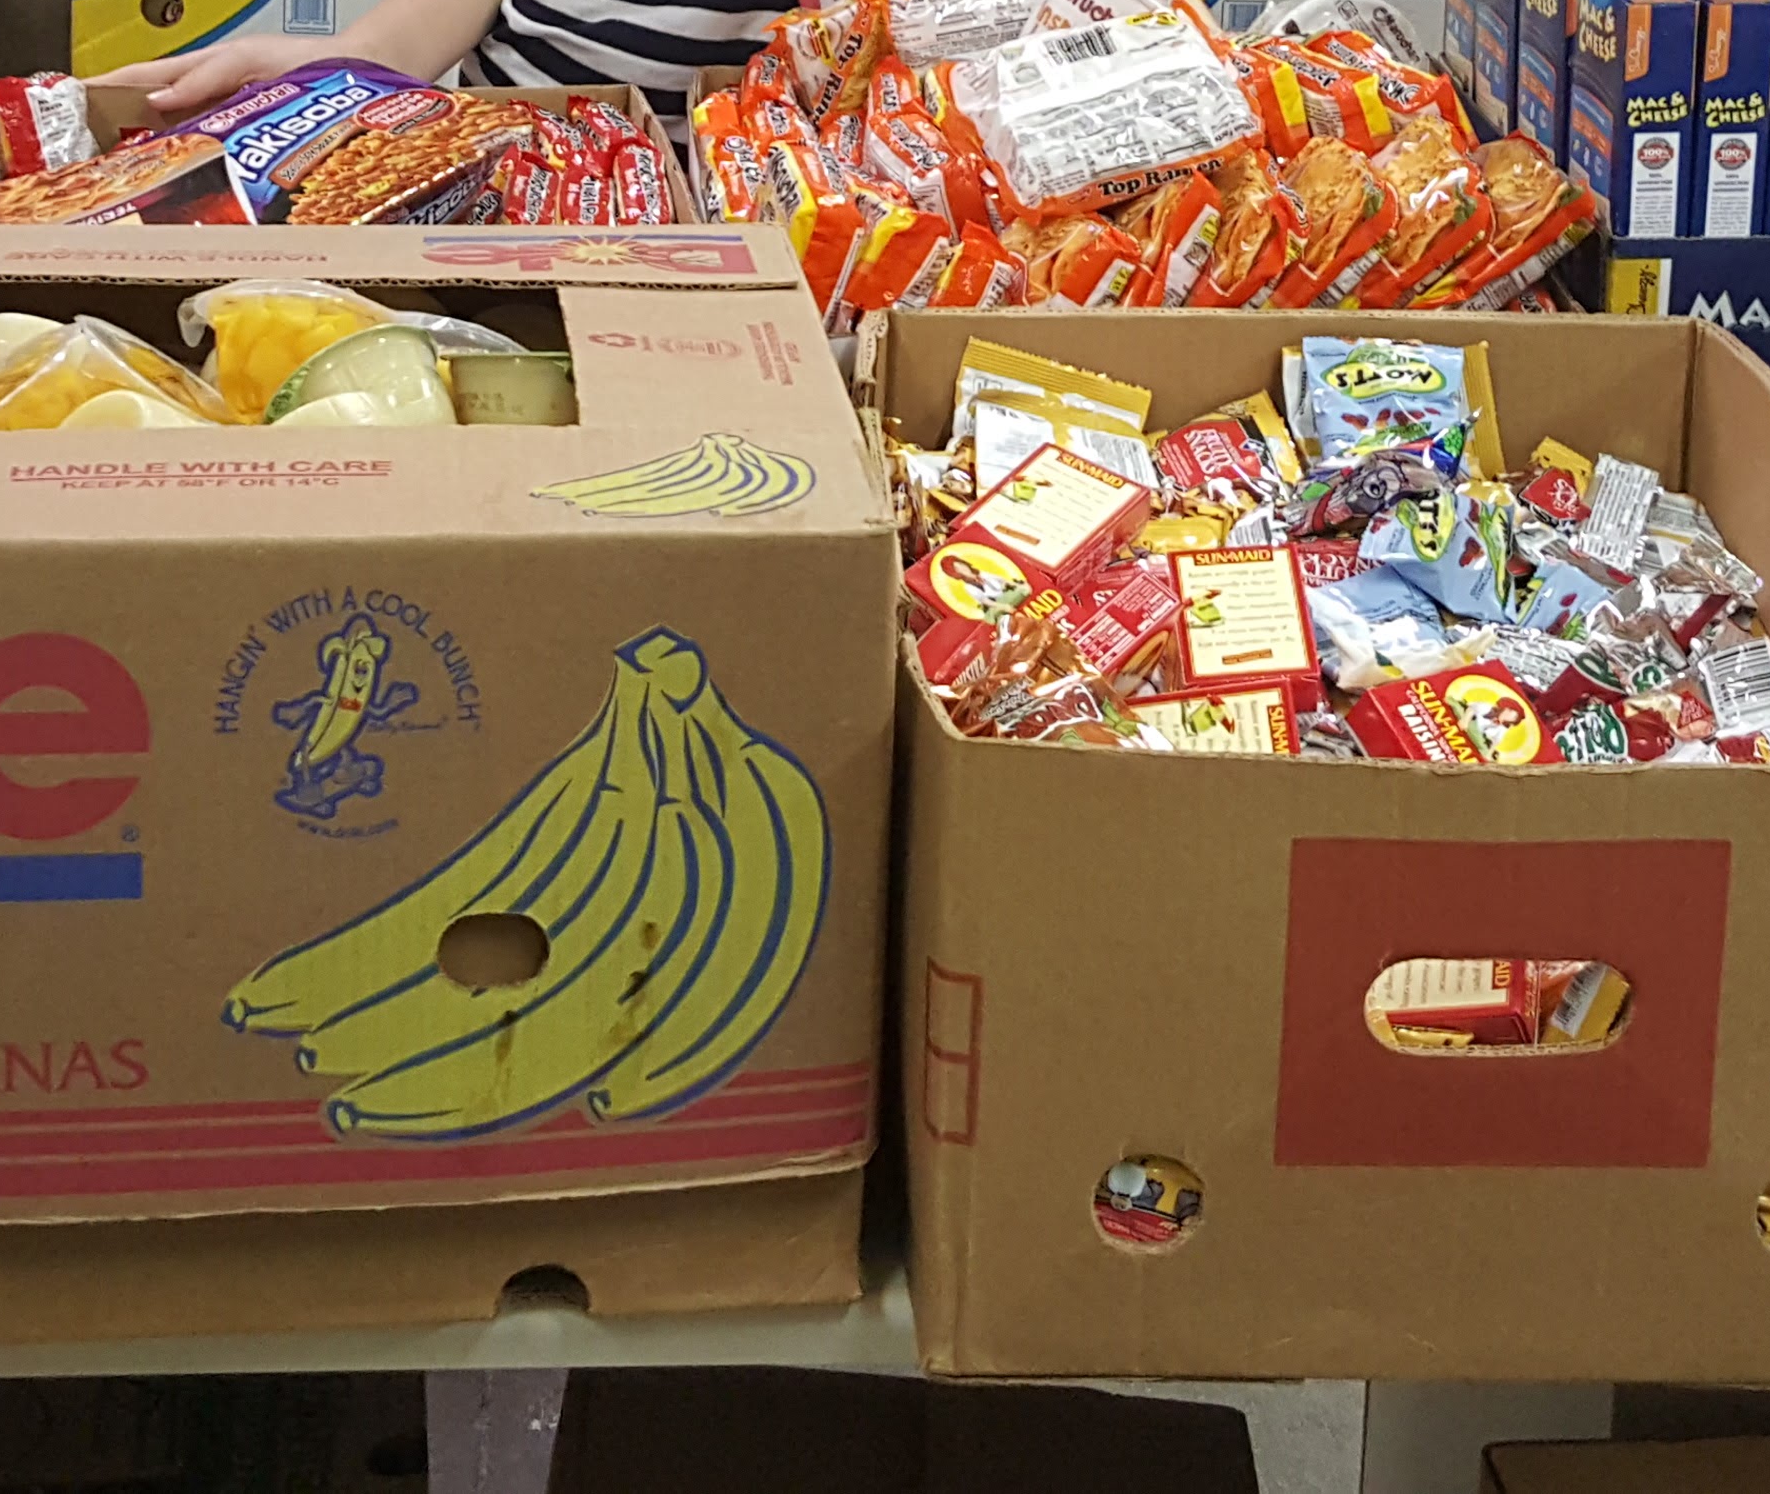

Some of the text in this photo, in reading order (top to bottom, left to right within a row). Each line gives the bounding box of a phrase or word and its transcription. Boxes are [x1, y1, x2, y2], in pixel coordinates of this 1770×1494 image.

[1628, 96, 1667, 110] MAC
[1629, 107, 1687, 127] CHEESE
[233, 84, 371, 181] Yakisoba
[1098, 175, 1141, 196] Top
[10, 460, 392, 480] HANDLE WITH CARE
[61, 478, 132, 490] KEEP
[140, 479, 168, 490] AT
[238, 478, 277, 488] OR
[264, 588, 334, 634] WITH
[342, 585, 357, 611] A
[365, 589, 432, 639] COOL
[432, 630, 482, 723] BUNCH
[1397, 704, 1446, 762] RAISIN
